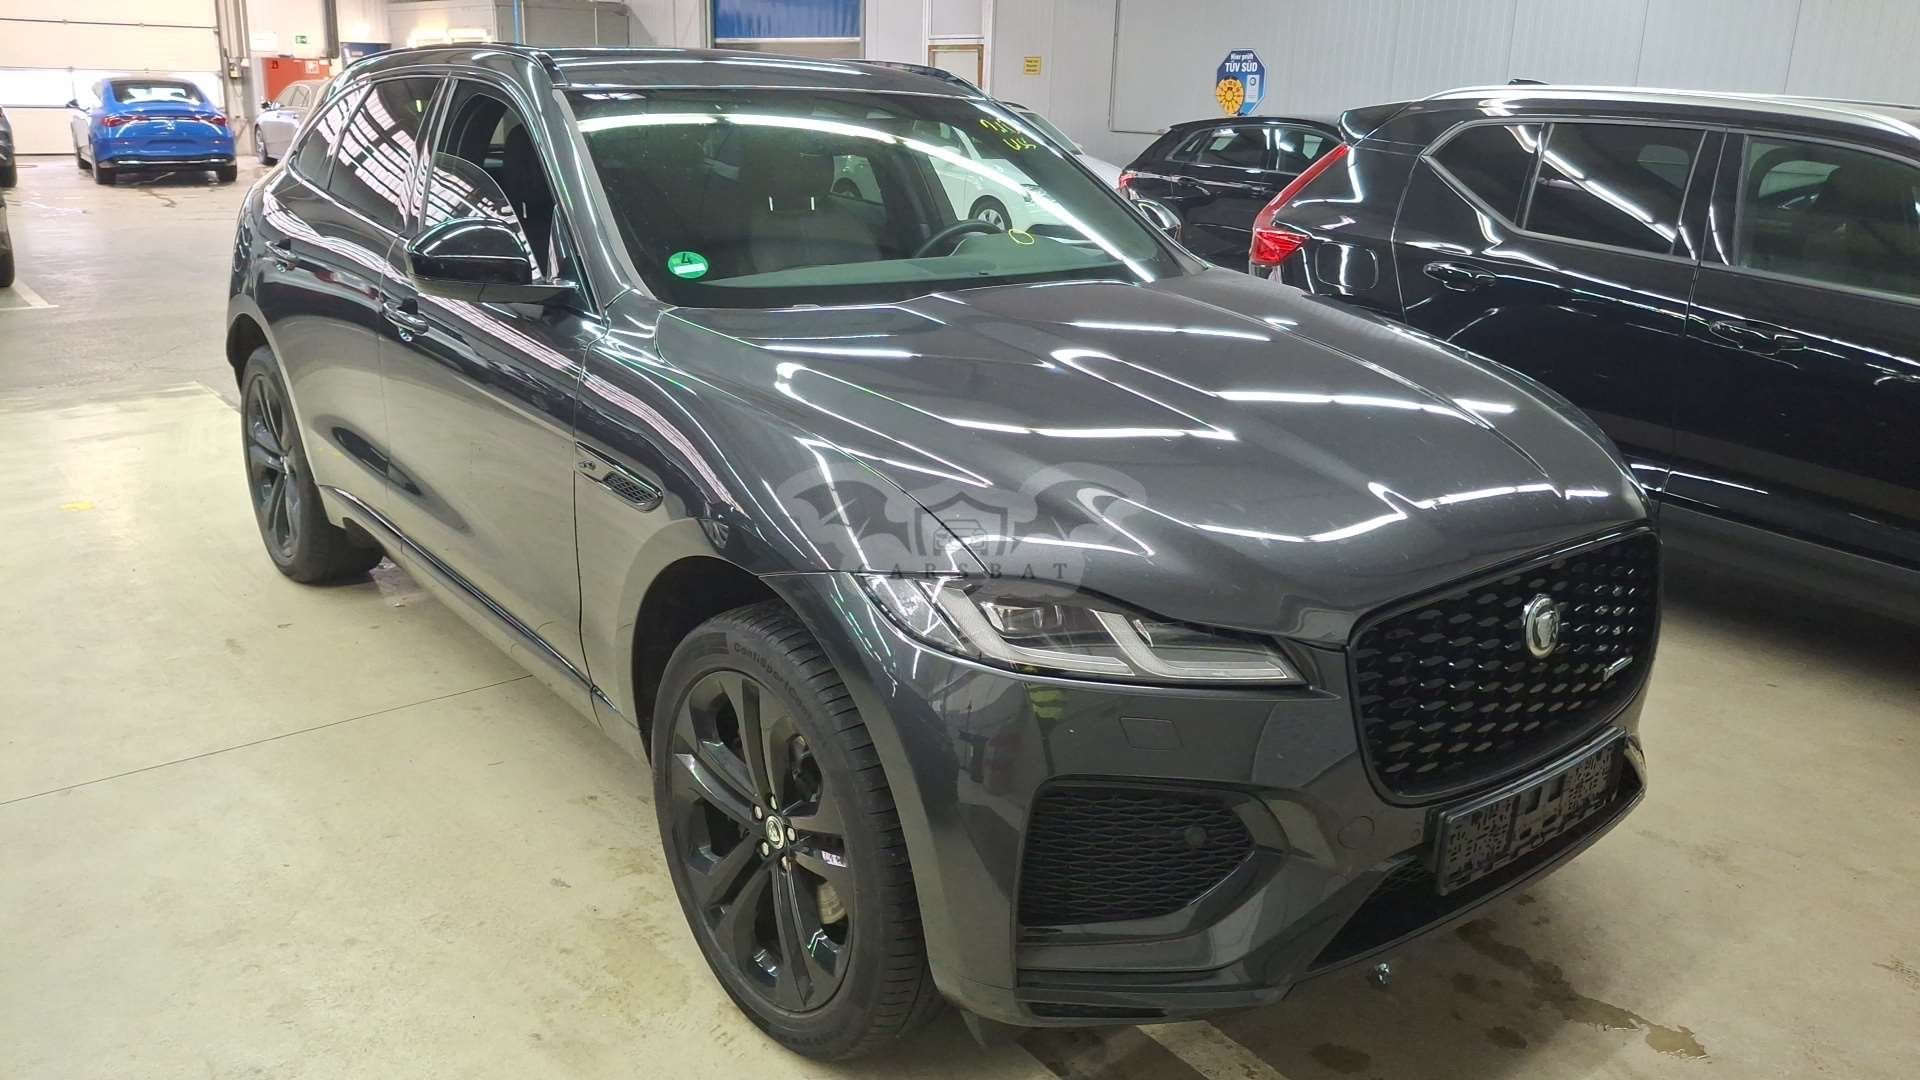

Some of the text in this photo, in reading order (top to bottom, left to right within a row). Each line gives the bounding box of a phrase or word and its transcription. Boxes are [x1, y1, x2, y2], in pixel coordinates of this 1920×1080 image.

[1225, 60, 1258, 73] TÜV SÜD
[681, 252, 692, 264] 4
